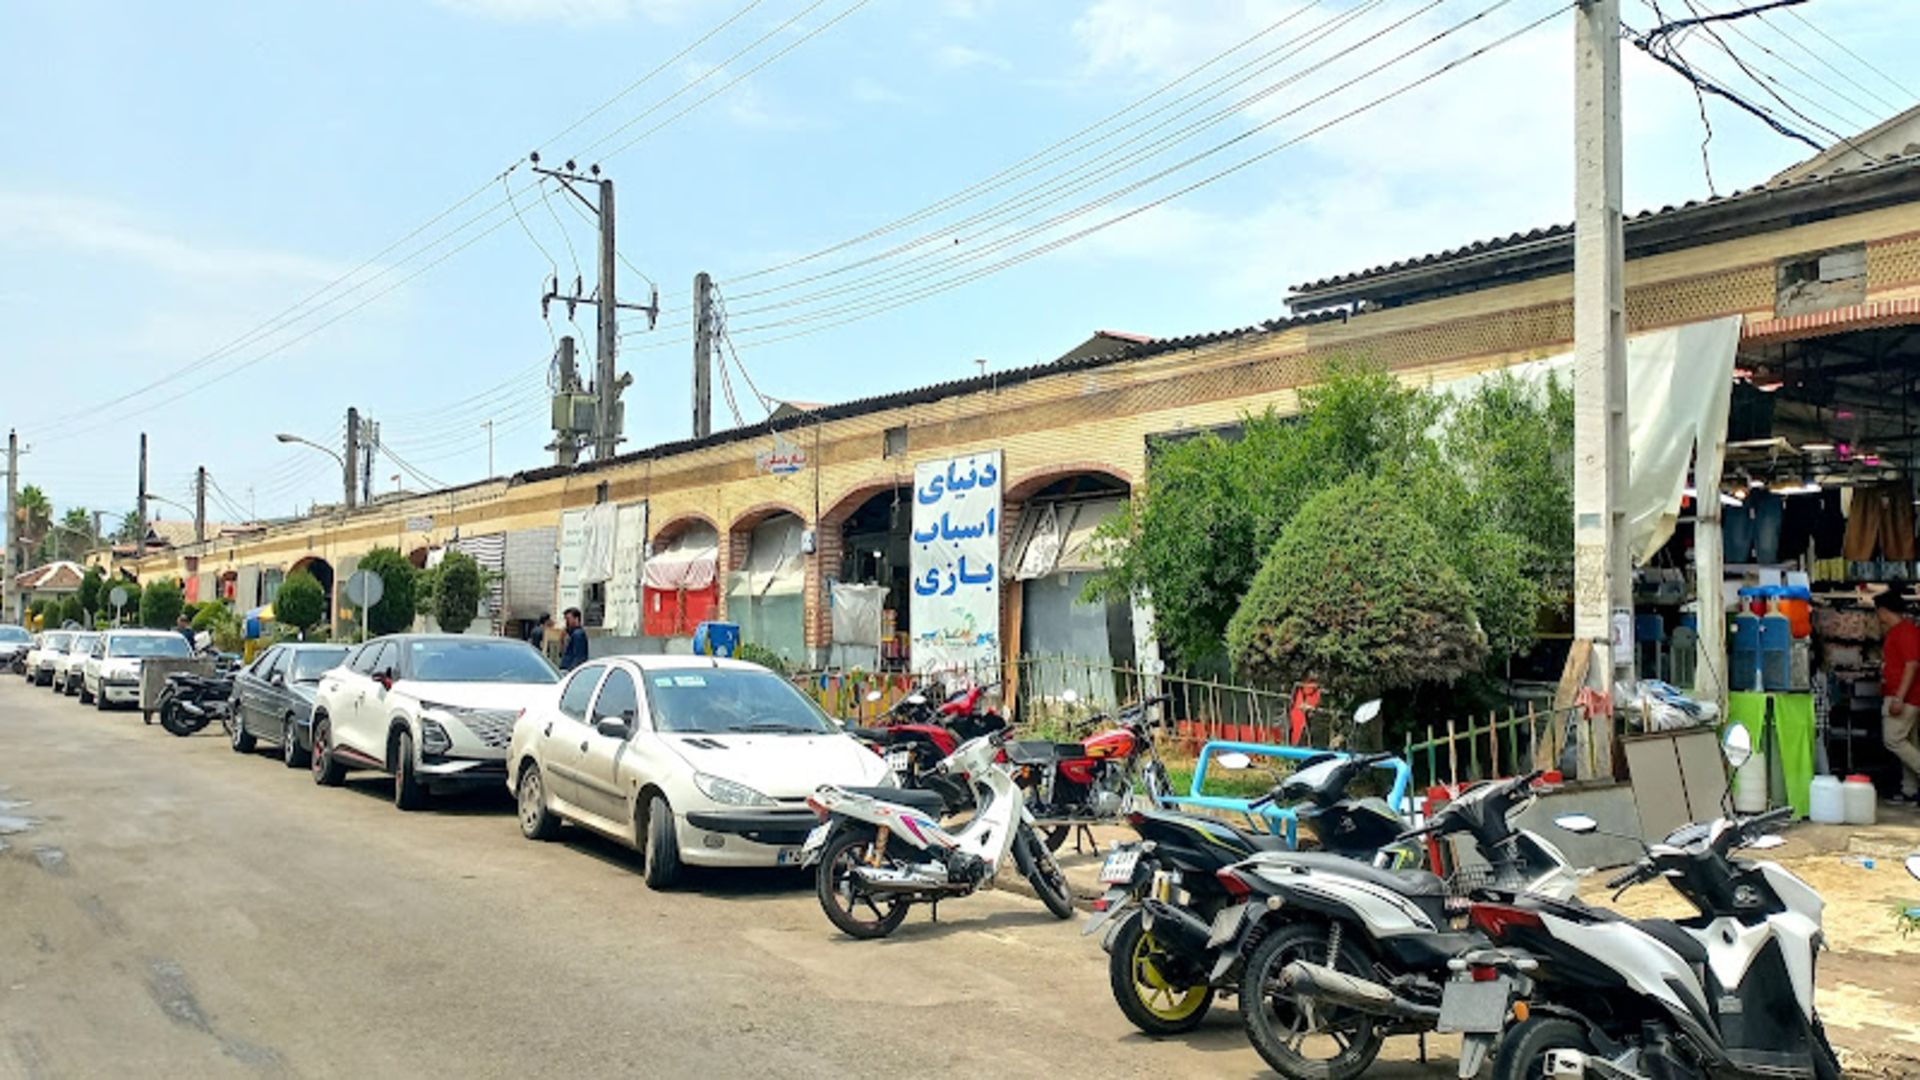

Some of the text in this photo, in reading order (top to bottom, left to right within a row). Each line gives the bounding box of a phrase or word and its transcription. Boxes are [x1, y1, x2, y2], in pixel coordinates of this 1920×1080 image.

[917, 459, 997, 505] دنیای
[913, 508, 996, 551] اسباب
[914, 554, 994, 596] بازی
